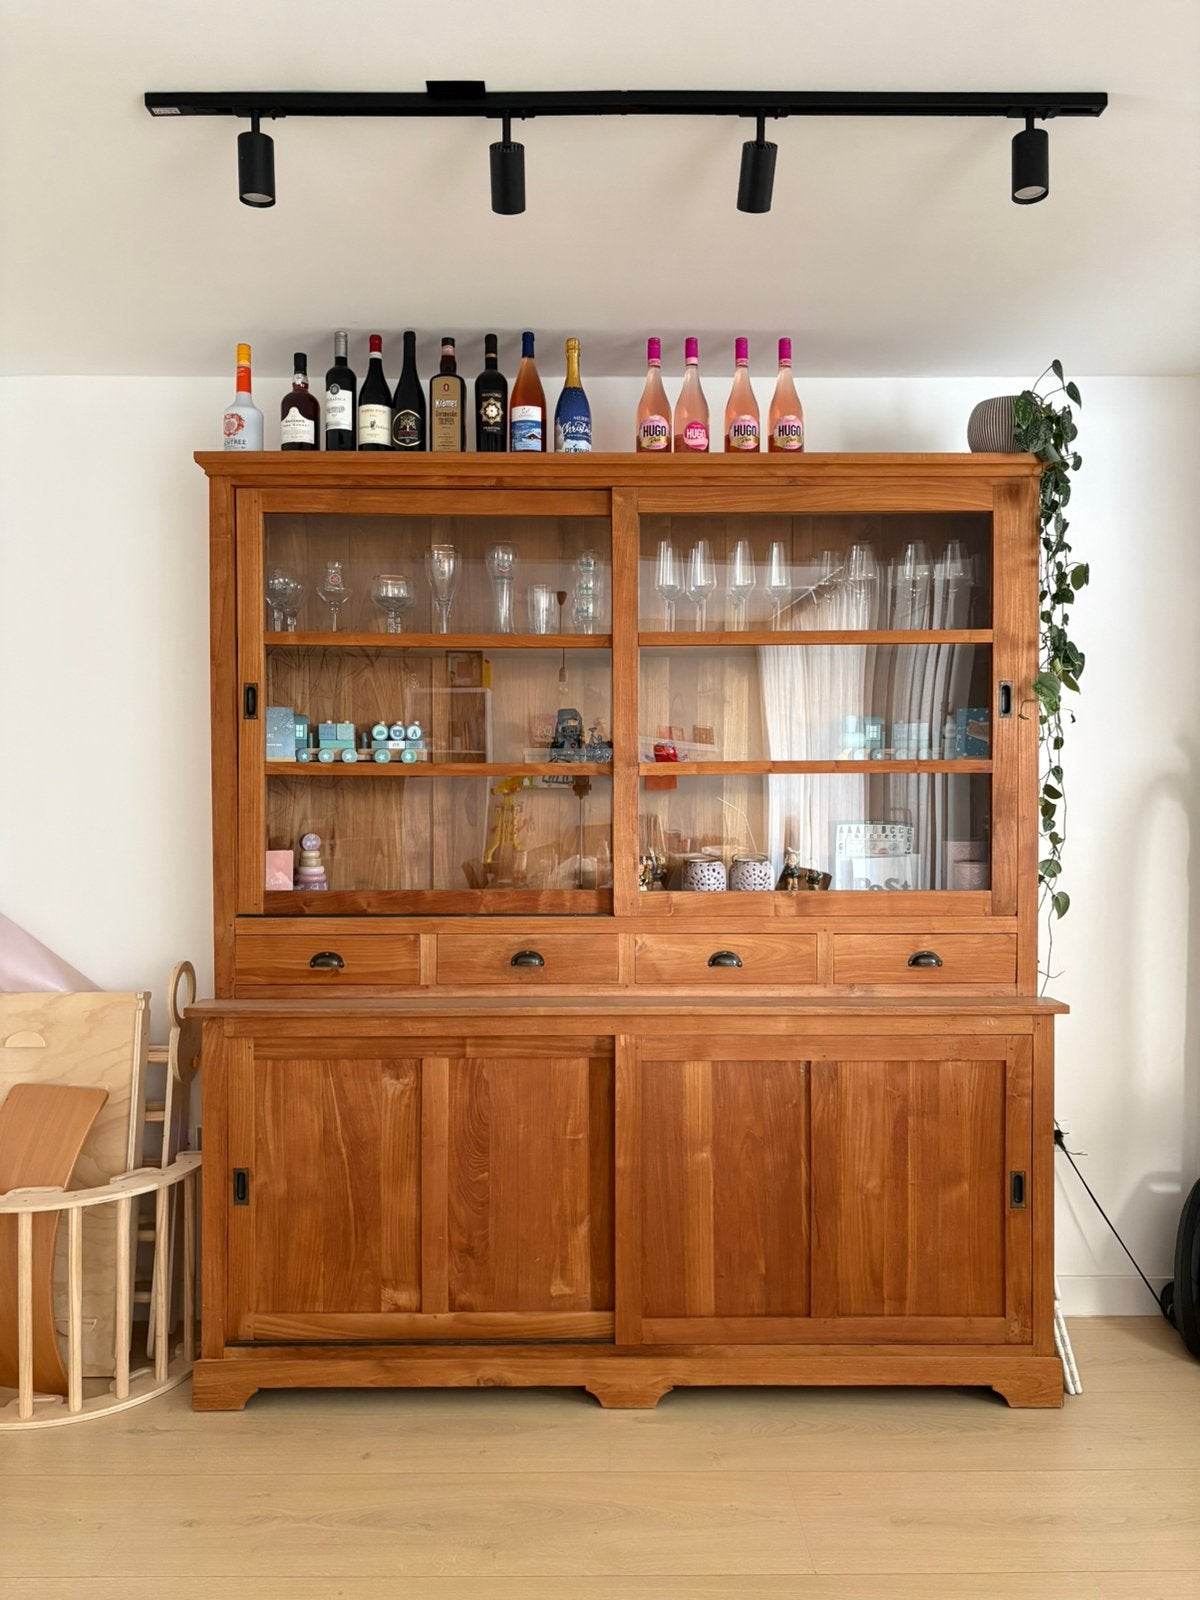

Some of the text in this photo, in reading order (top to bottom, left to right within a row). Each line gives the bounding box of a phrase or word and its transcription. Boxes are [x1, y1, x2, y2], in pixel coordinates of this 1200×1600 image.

[643, 424, 667, 438] HUGO
[686, 428, 707, 439] HUGO
[733, 424, 757, 437] HUGO
[778, 424, 801, 437] HUGO
